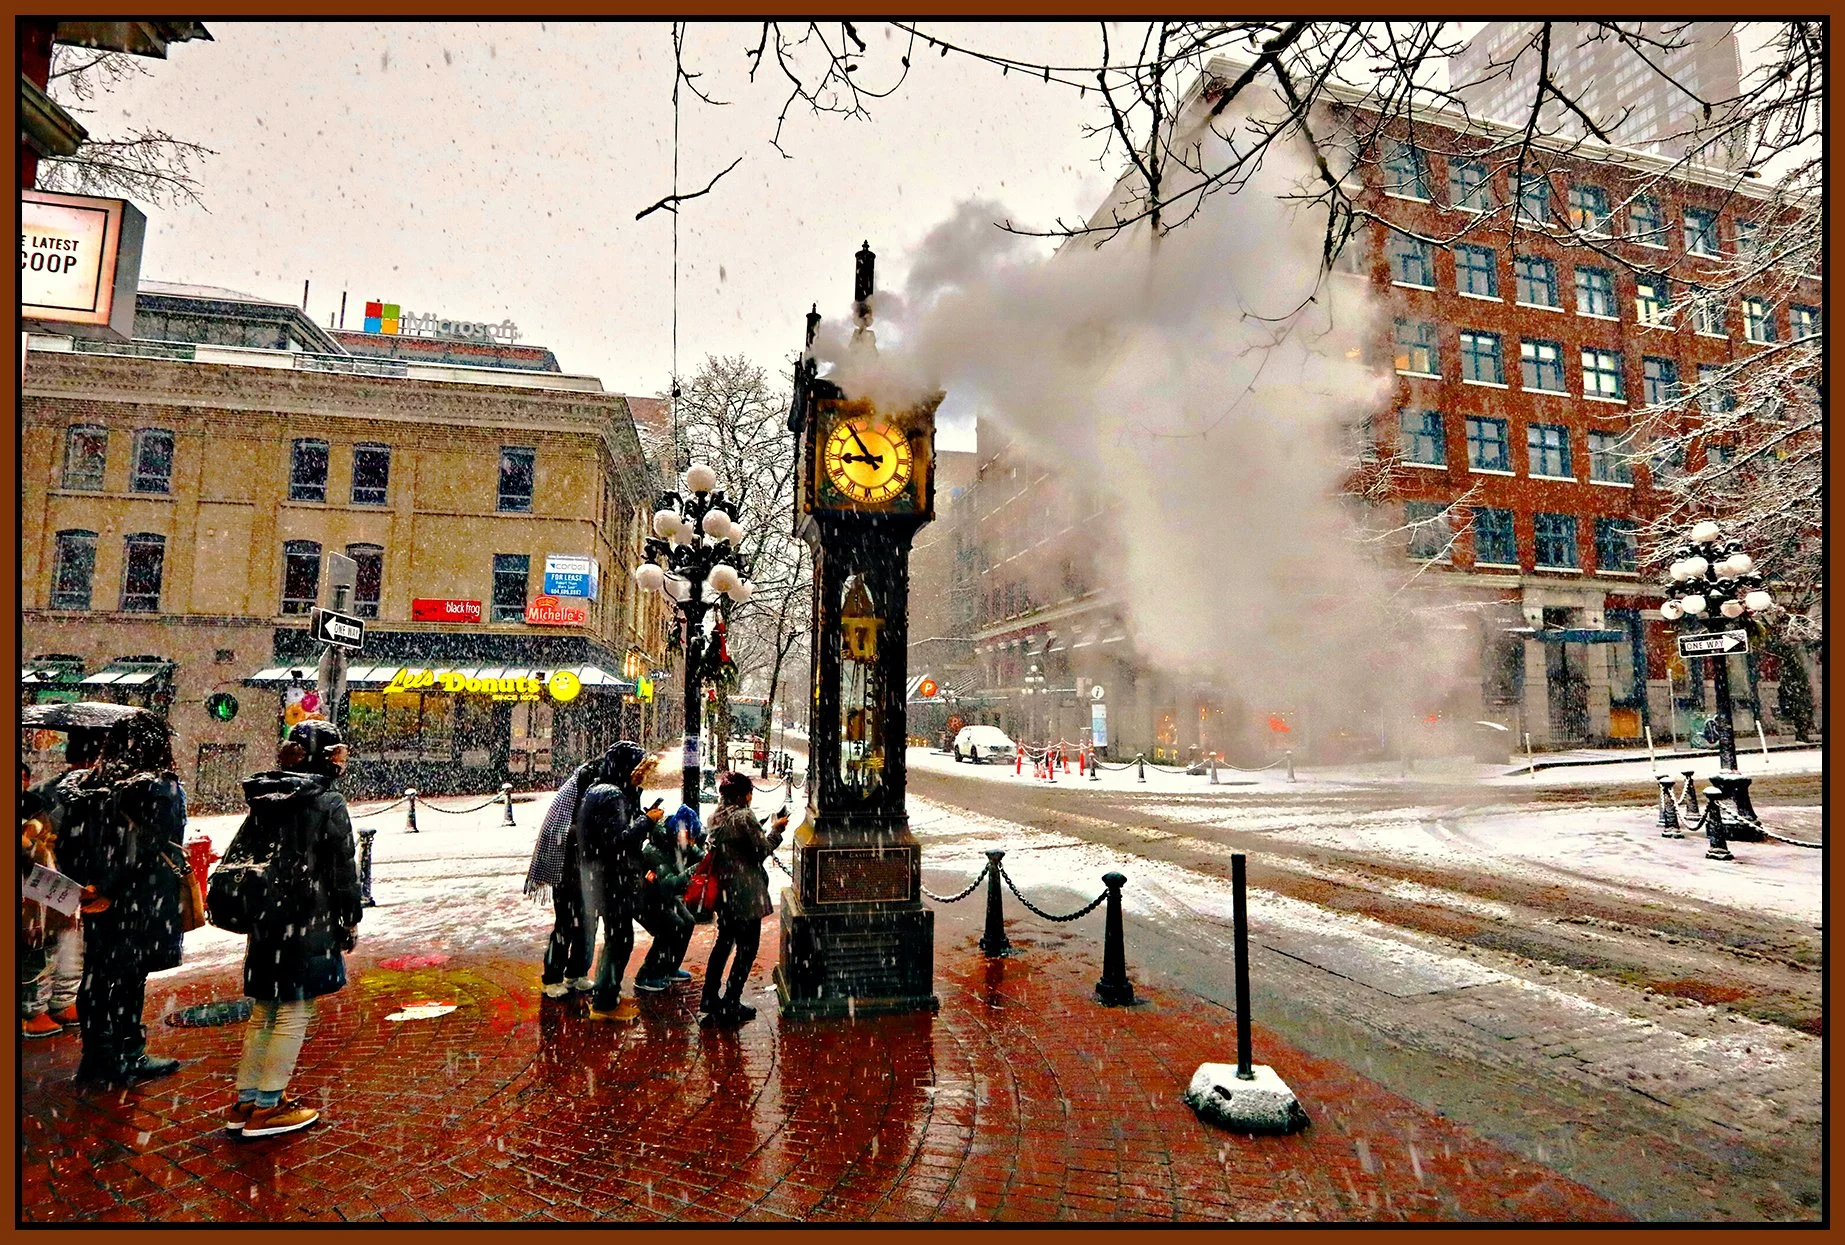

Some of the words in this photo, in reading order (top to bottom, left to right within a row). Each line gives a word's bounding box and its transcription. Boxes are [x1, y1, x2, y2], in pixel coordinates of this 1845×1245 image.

[32, 236, 80, 252] LATEST
[406, 310, 518, 340] Microsoft
[551, 573, 564, 581] FOR
[564, 574, 583, 582] LEASE
[445, 601, 465, 614] black
[465, 601, 481, 617] frog
[334, 622, 346, 636] ONE
[347, 626, 360, 638] WAY
[1686, 642, 1704, 651] ONE
[1706, 640, 1724, 649] WAY
[383, 667, 435, 695] Lee's
[437, 672, 541, 694] Donuts
[924, 682, 933, 693] P
[492, 694, 518, 702] SINCE
